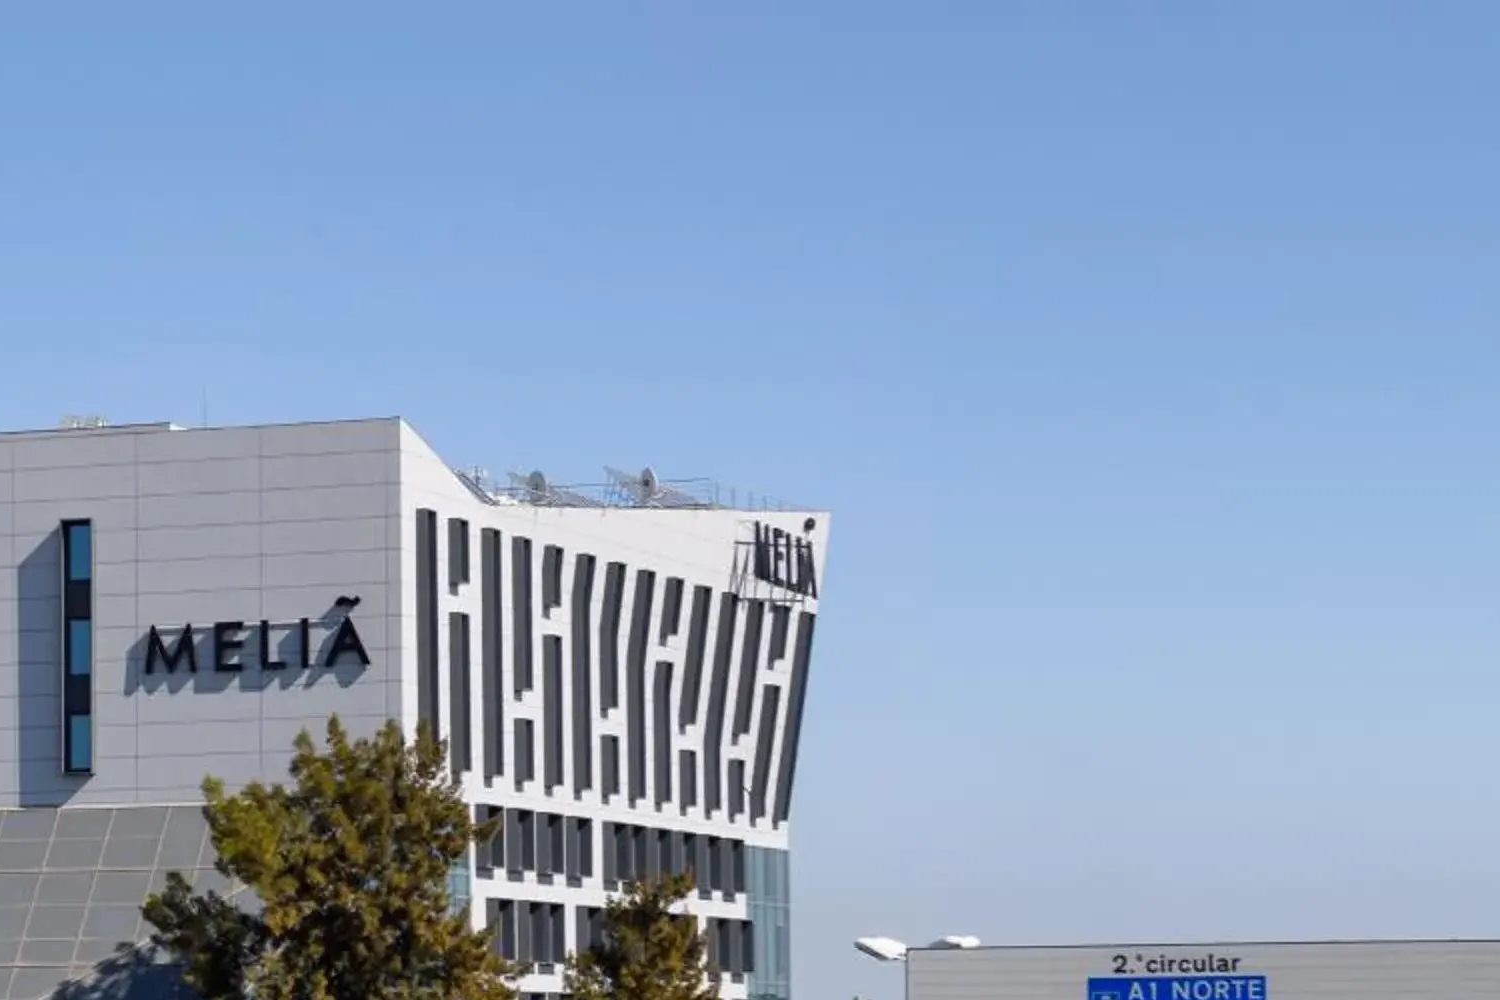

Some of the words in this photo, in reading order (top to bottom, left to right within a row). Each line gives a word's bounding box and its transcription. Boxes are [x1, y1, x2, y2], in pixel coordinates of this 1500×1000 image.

[145, 596, 371, 674] MELIÁ
[1146, 954, 1242, 974] circular
[1128, 982, 1157, 1000] A1
[1171, 980, 1263, 1000] NORTE
